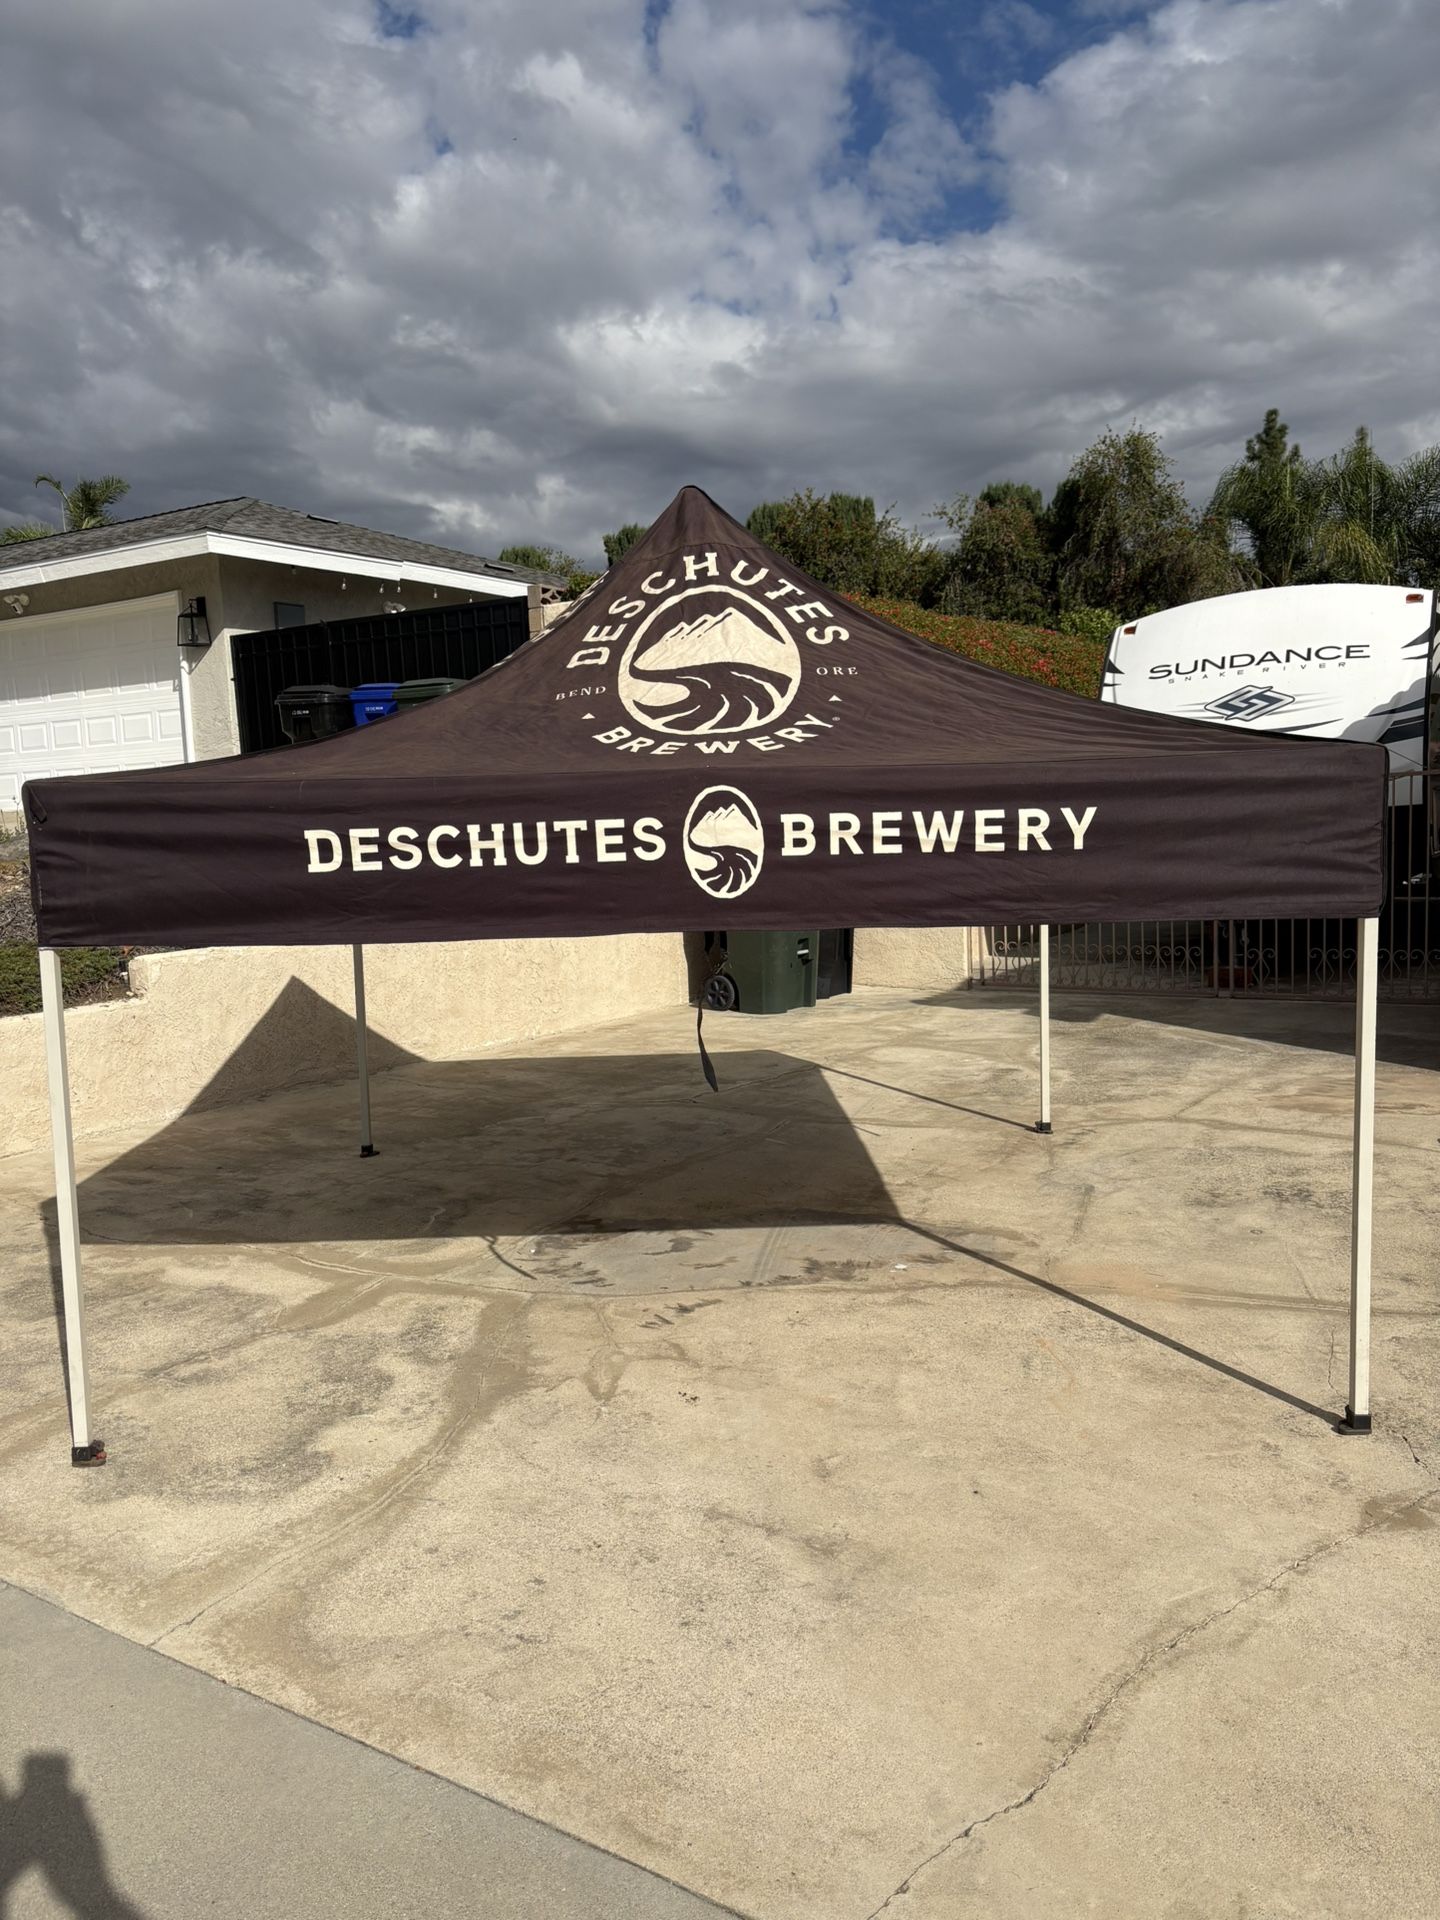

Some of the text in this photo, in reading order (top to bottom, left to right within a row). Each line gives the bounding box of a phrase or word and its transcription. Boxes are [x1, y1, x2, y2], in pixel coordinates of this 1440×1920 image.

[566, 552, 850, 669] DESCHUTES
[816, 666, 859, 676] ORE
[1148, 644, 1371, 680] SUNDANCE
[1168, 661, 1347, 684] SNAKE RIVER
[555, 686, 607, 700] BEND
[592, 713, 834, 755] BREWERY
[303, 806, 1098, 873] DESCHUTES BREWERY
